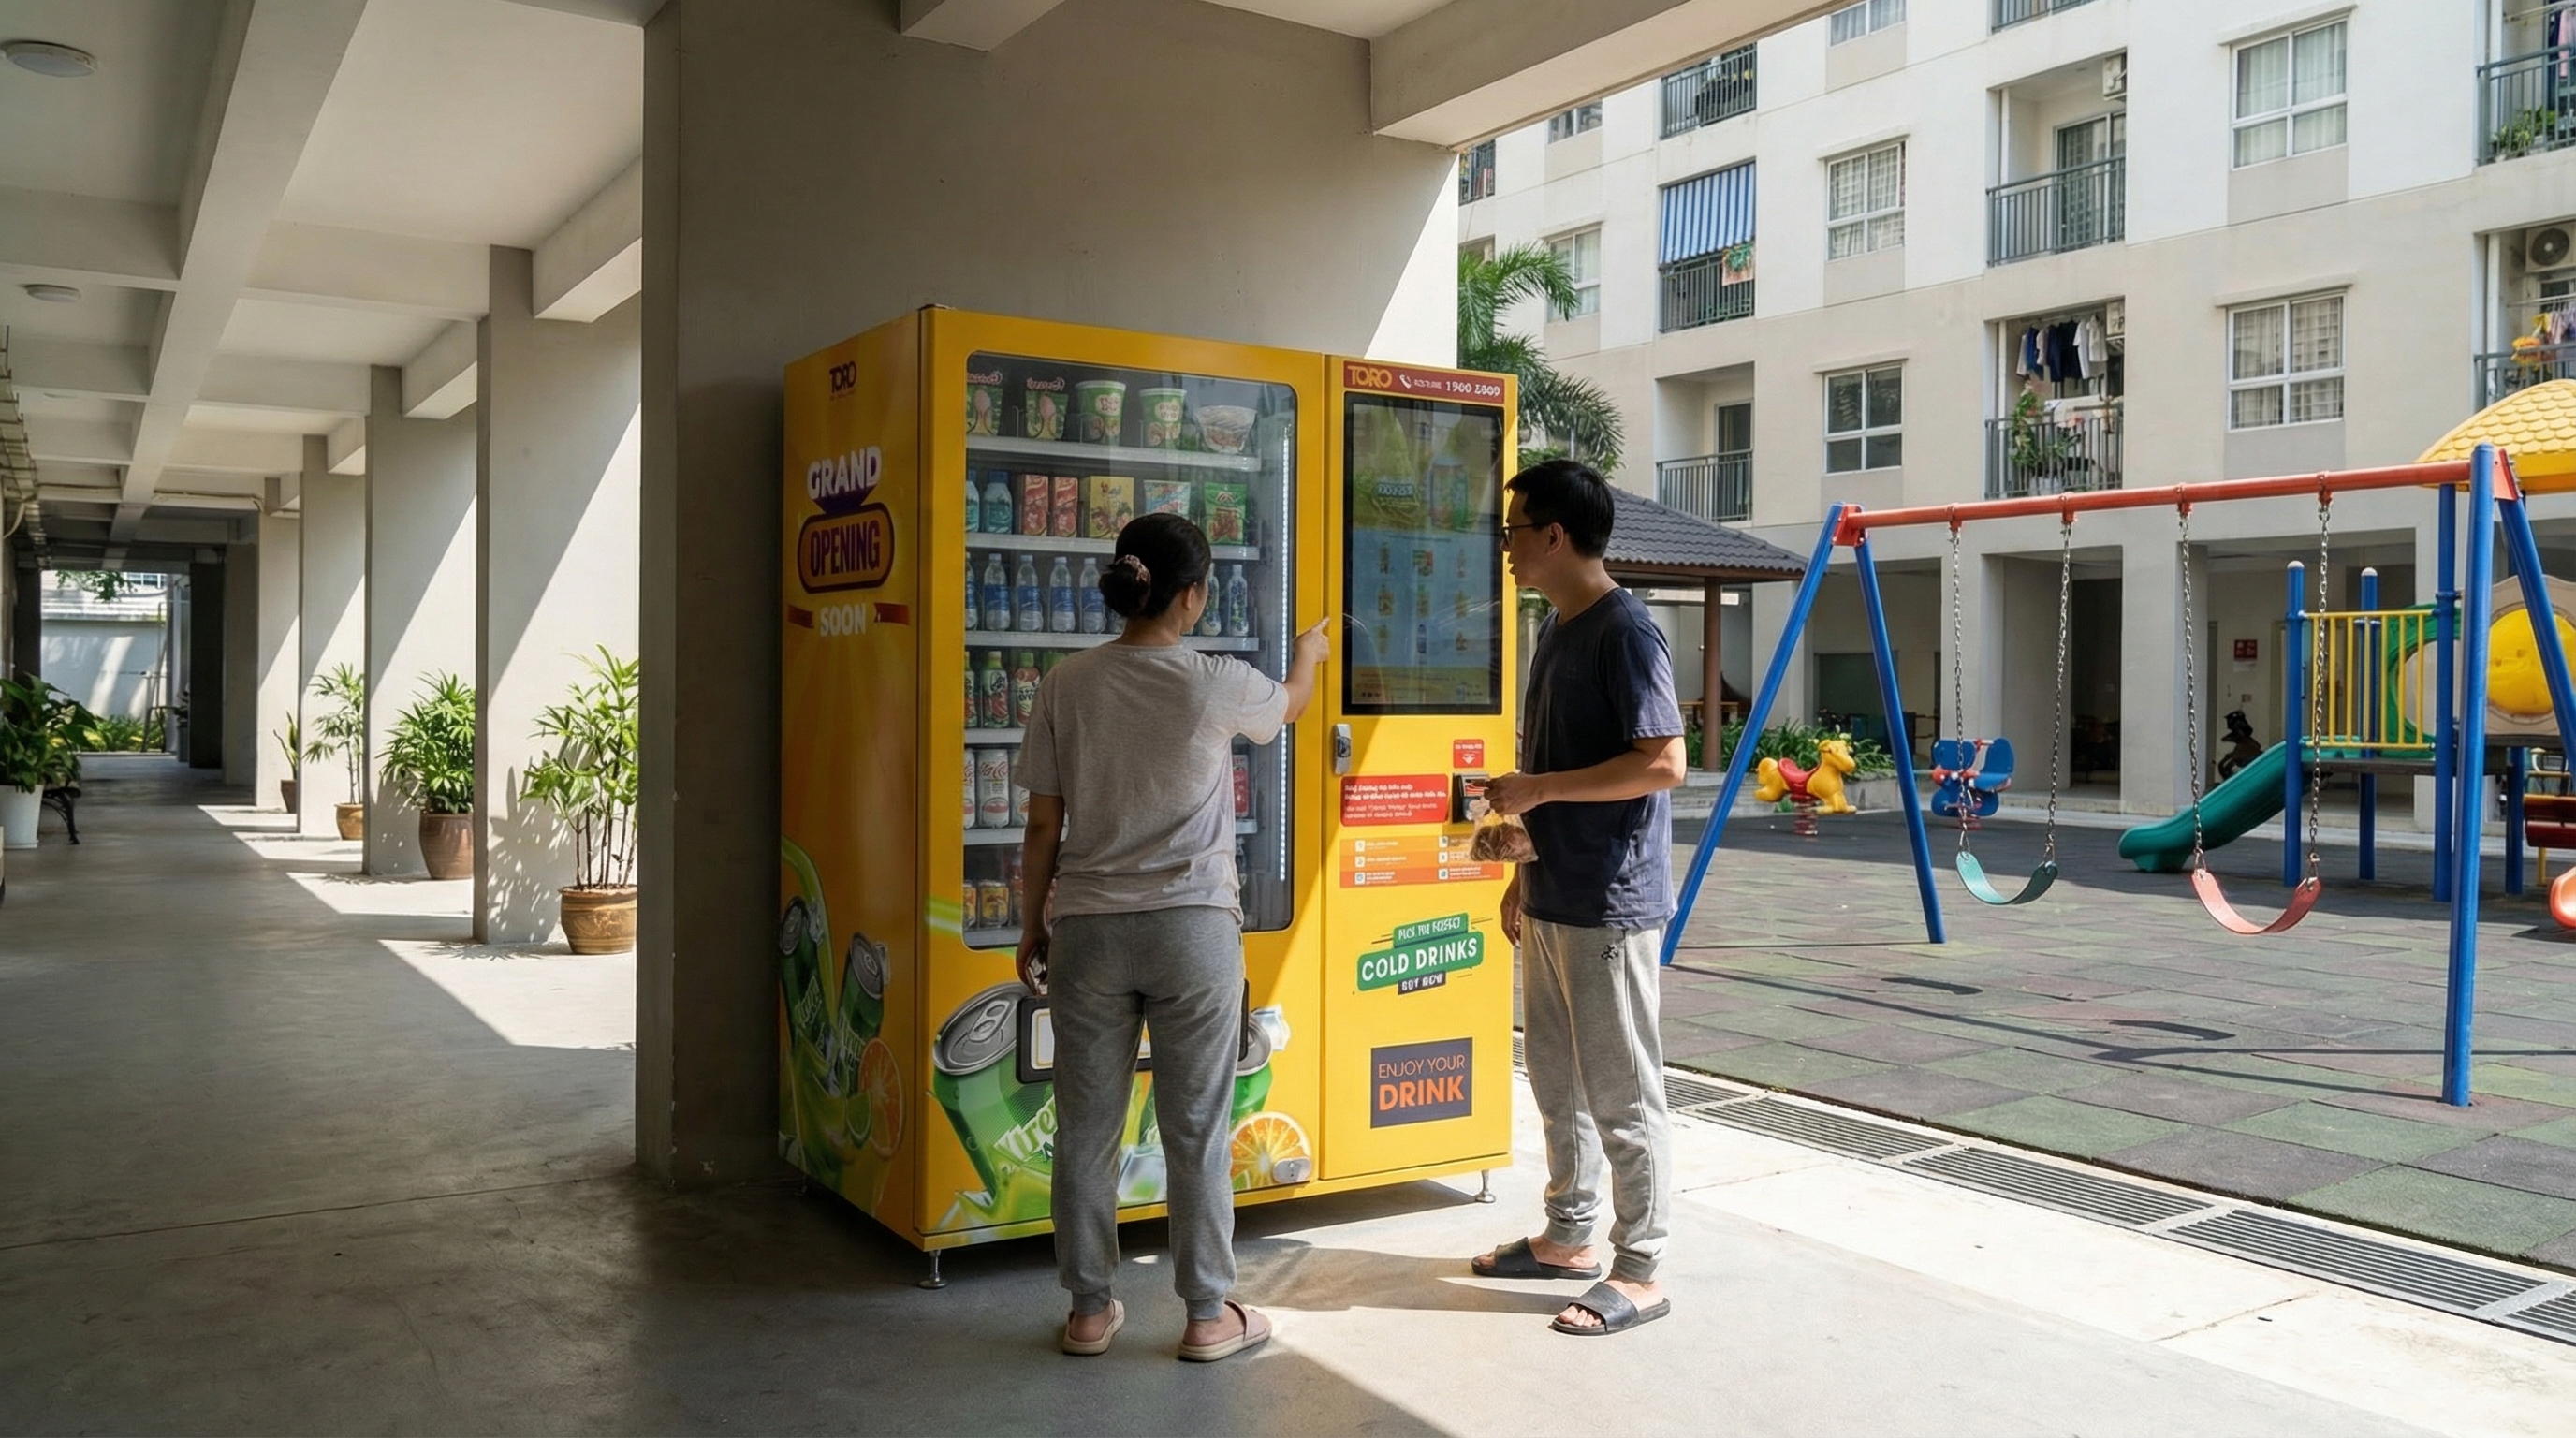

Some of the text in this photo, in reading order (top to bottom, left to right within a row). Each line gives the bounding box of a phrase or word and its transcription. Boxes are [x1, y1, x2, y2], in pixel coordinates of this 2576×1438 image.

[1347, 365, 1392, 388] TORO
[807, 446, 883, 501] GRAND
[810, 520, 880, 577] OPENING
[820, 603, 867, 637] SOON
[1362, 937, 1478, 981] COLD DRINKS
[1378, 1054, 1466, 1078] ENJOY YOUR
[1379, 1075, 1465, 1111] DRINK
